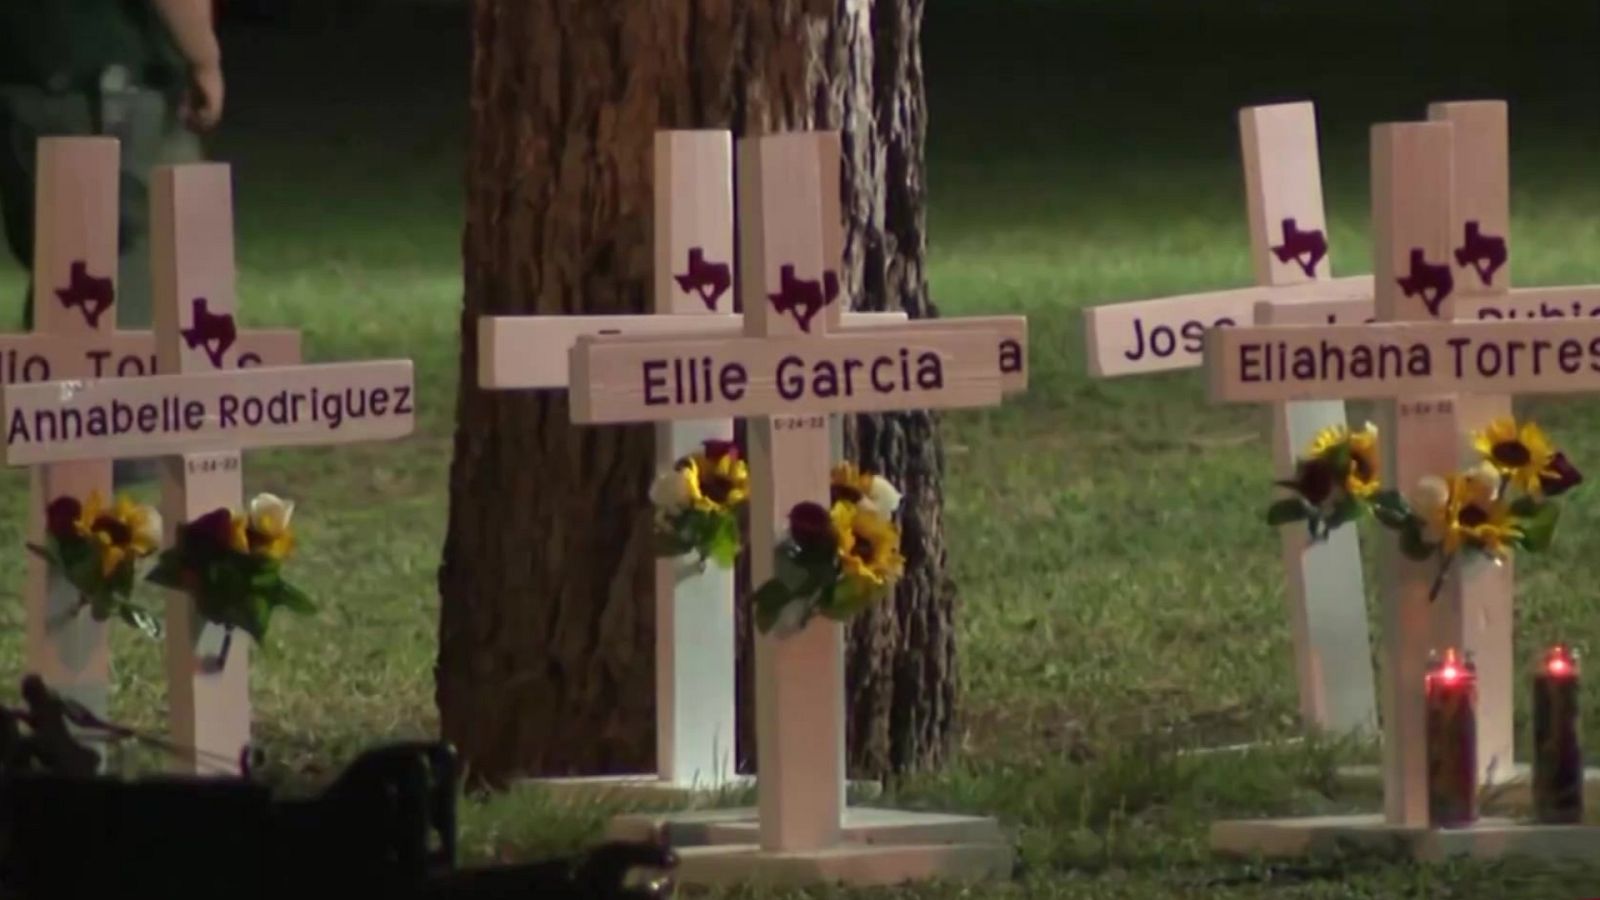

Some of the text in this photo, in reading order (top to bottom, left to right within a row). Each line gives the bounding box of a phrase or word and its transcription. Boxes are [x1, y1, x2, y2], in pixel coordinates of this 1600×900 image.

[1125, 317, 1236, 361] Jos
[1239, 336, 1600, 382] Eliahana Torres
[642, 347, 944, 406] Ellie Garcia
[7, 384, 413, 445] Annabelle Rodriguez
